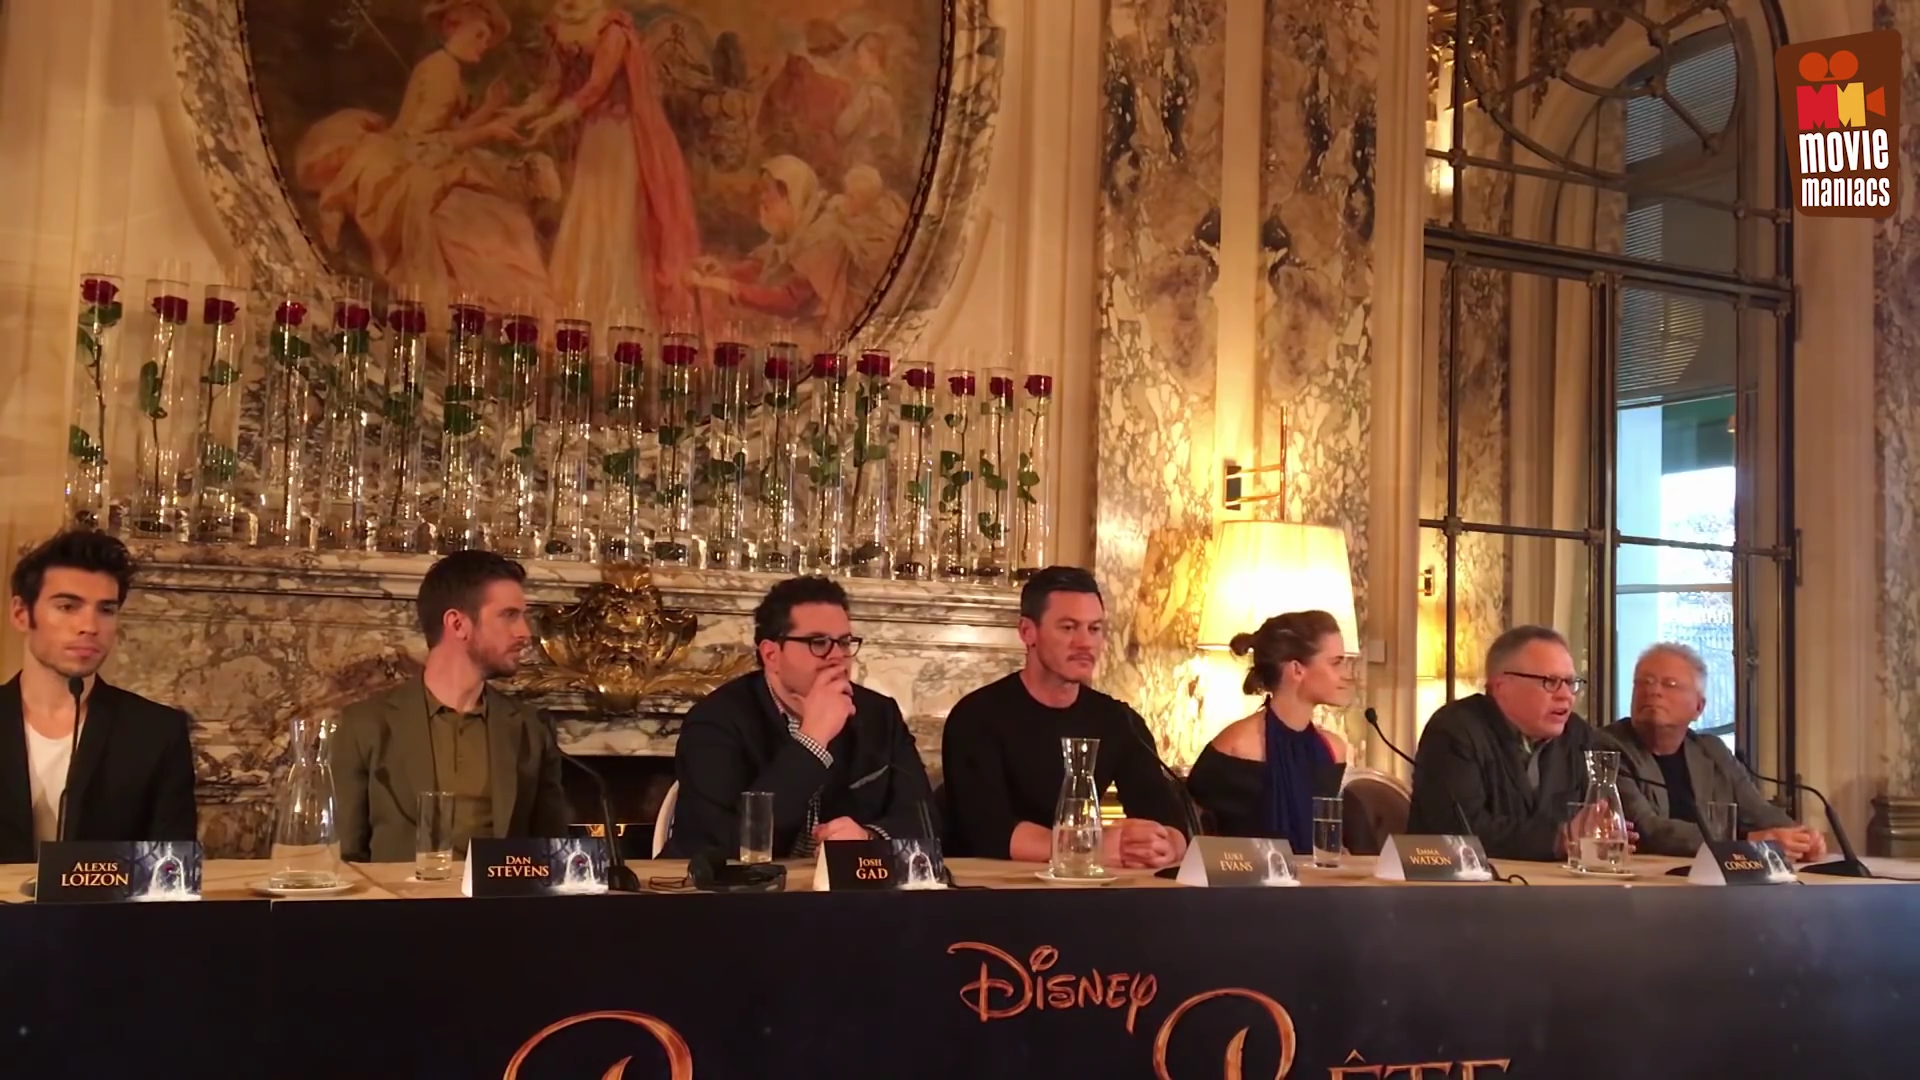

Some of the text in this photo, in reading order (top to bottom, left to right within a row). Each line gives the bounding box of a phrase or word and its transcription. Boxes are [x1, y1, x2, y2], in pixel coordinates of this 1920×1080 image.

[505, 855, 531, 865] DAN
[858, 857, 882, 868] JOSH
[1409, 855, 1452, 866] WATSON
[1724, 860, 1764, 871] CONDON
[72, 861, 118, 872] ALEXIS
[487, 865, 549, 878] STEVENS
[1220, 860, 1253, 872] EVANS
[855, 867, 889, 880] GAD
[61, 873, 129, 887] LOIZON
